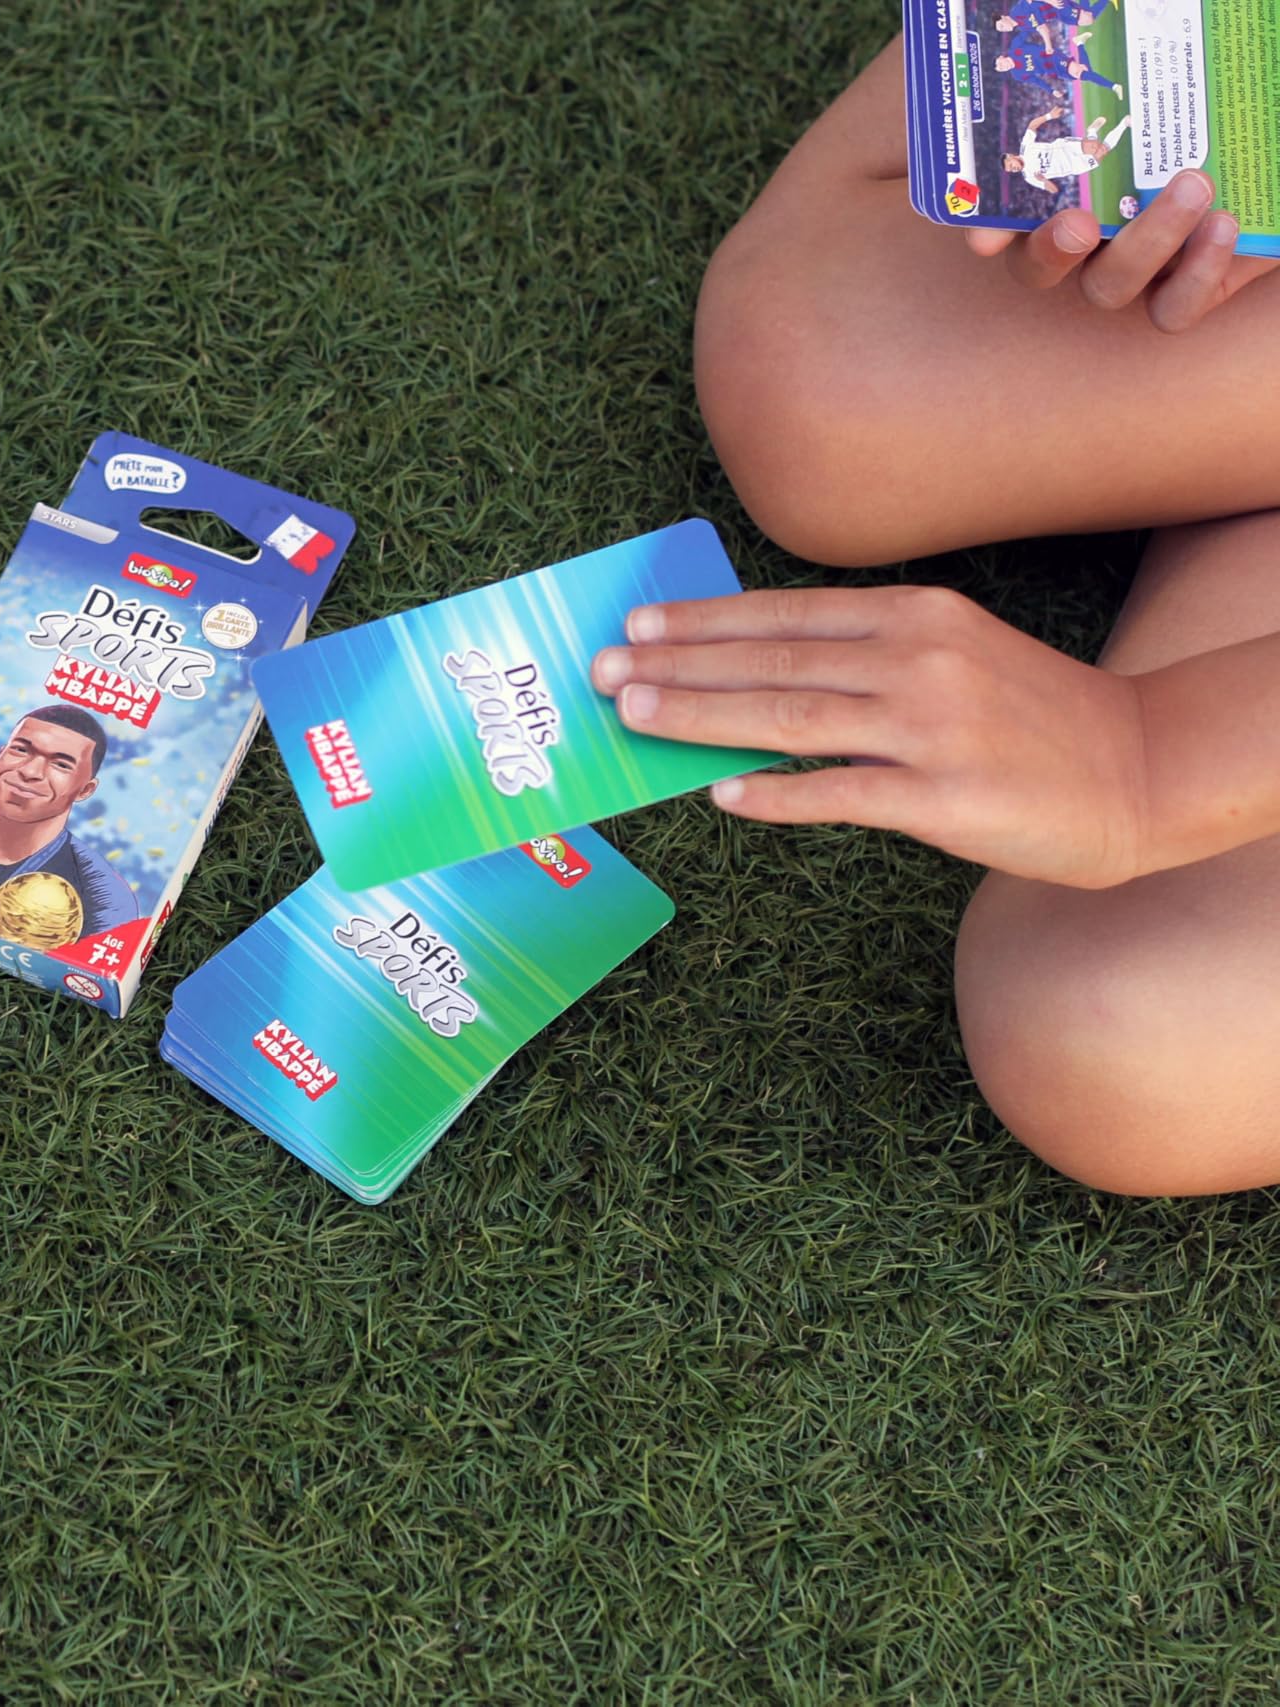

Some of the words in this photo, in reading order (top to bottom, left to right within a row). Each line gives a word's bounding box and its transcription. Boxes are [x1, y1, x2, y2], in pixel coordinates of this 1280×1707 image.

[936, 0, 946, 28] CLAS
[1182, 18, 1192, 32] 6,9
[1210, 9, 1220, 30] Après
[1222, 9, 1232, 43] s'impose
[1233, 15, 1241, 35] lance
[939, 33, 947, 48] EN
[1245, 21, 1255, 46] frappe
[1257, 35, 1268, 61] malgré
[969, 42, 978, 63] 2025
[1183, 41, 1195, 88] générale
[1235, 37, 1245, 82] Bellingham
[1247, 48, 1255, 70] d'une
[940, 52, 951, 105] VICTOIRE
[971, 65, 980, 98] octobre
[1138, 51, 1148, 98] décisives
[1154, 69, 1163, 79] 10
[1250, 72, 1258, 102] marque
[1259, 64, 1267, 82] mais
[973, 100, 981, 110] 26
[1170, 82, 1180, 119] réussis
[1214, 79, 1222, 108] victoire
[1237, 85, 1245, 102] Jude
[1141, 101, 1150, 137] Passes
[1155, 89, 1165, 133] réussies
[1186, 91, 1197, 158] Performance
[1227, 111, 1235, 135] saison
[941, 108, 955, 164] PREMIÈRE
[1215, 111, 1226, 146] première
[1261, 118, 1272, 147] rejoints
[1157, 136, 1167, 171] Passes
[1172, 122, 1182, 166] Dribbles
[1263, 150, 1271, 166] sont
[1143, 151, 1152, 175] Buts
[1229, 147, 1237, 178] défaites
[1252, 152, 1263, 196] profondeur
[1218, 160, 1229, 197] remporte
[1230, 180, 1240, 206] quatre
[950, 196, 960, 210] 10
[1242, 185, 1253, 215] premier
[1266, 214, 1274, 226] Les
[114, 458, 143, 470] PRÊTS
[126, 476, 167, 487] BATAILLE
[172, 471, 181, 488] ?
[40, 510, 78, 529] STARS
[82, 588, 183, 645] Défis
[205, 620, 252, 638] BRILLANTE
[29, 615, 210, 695] SPORTS
[52, 654, 157, 703] KYLIAN
[43, 672, 148, 720] MBAPPÉ
[503, 663, 556, 746] Défis
[447, 651, 548, 792] SPORTS
[308, 725, 356, 802] MBAPPÉ
[325, 719, 371, 797] KYLIAN
[87, 943, 121, 966] 7+
[102, 935, 124, 950] ÂGE
[388, 912, 464, 983] Défis
[337, 918, 474, 1032] SPORTS
[251, 1031, 326, 1093] MBAPPÉ
[264, 1019, 337, 1083] KYLIAN
